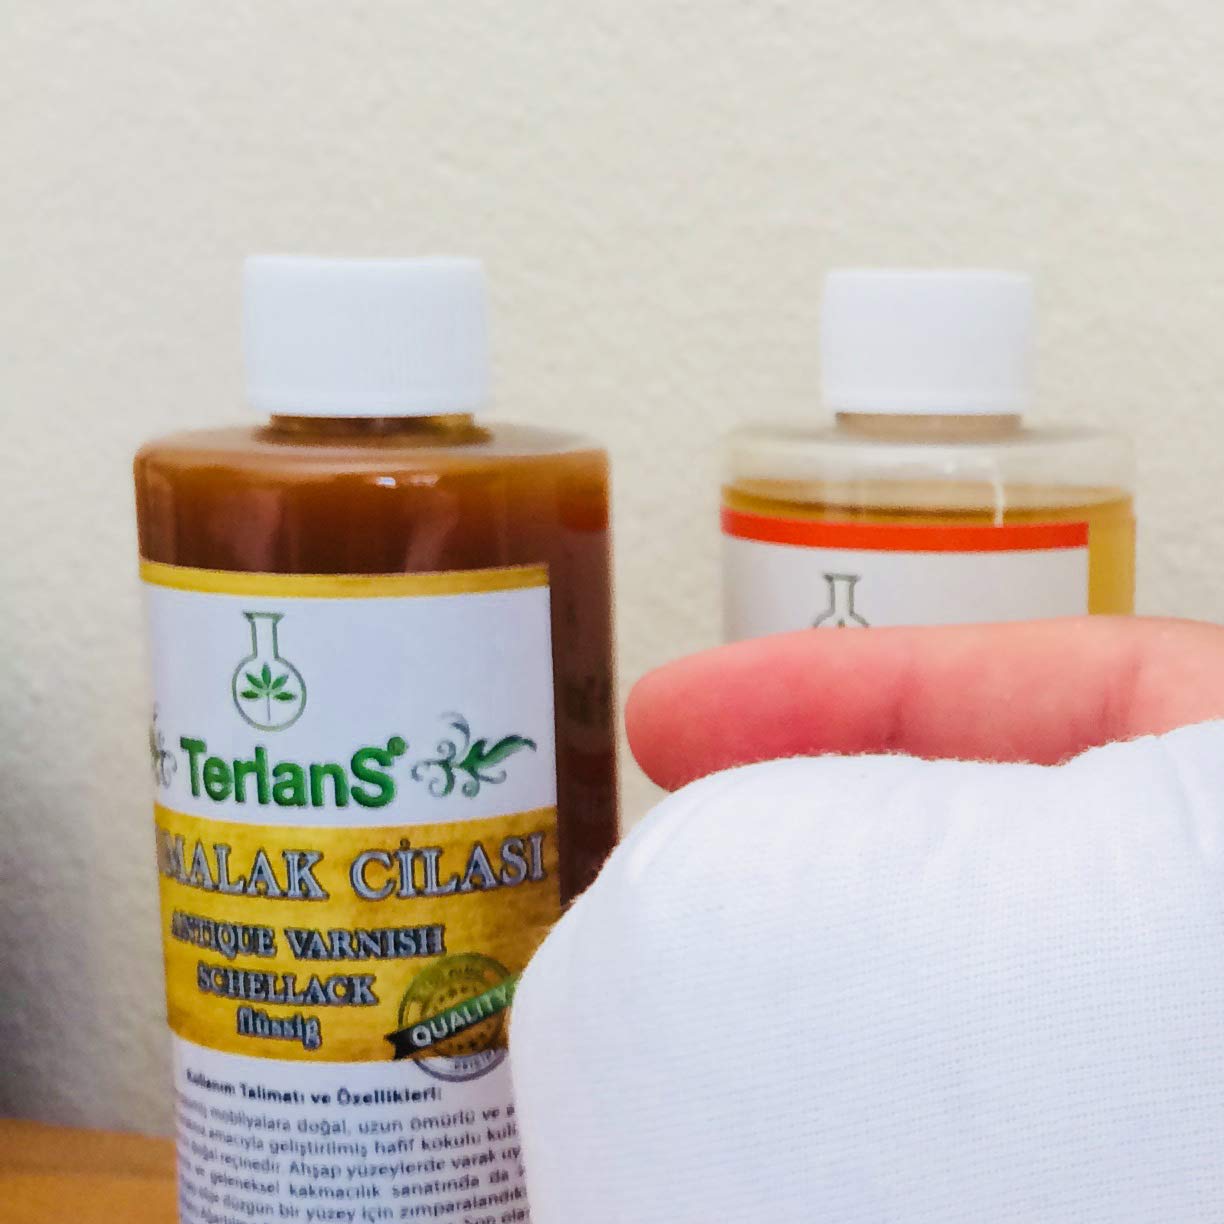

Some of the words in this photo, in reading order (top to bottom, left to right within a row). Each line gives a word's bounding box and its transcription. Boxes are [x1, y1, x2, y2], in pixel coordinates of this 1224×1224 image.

[157, 829, 330, 900] MALAK
[348, 832, 547, 900] CİLASI
[284, 923, 447, 961] VARNISH
[197, 960, 379, 1006] SCHELLACK
